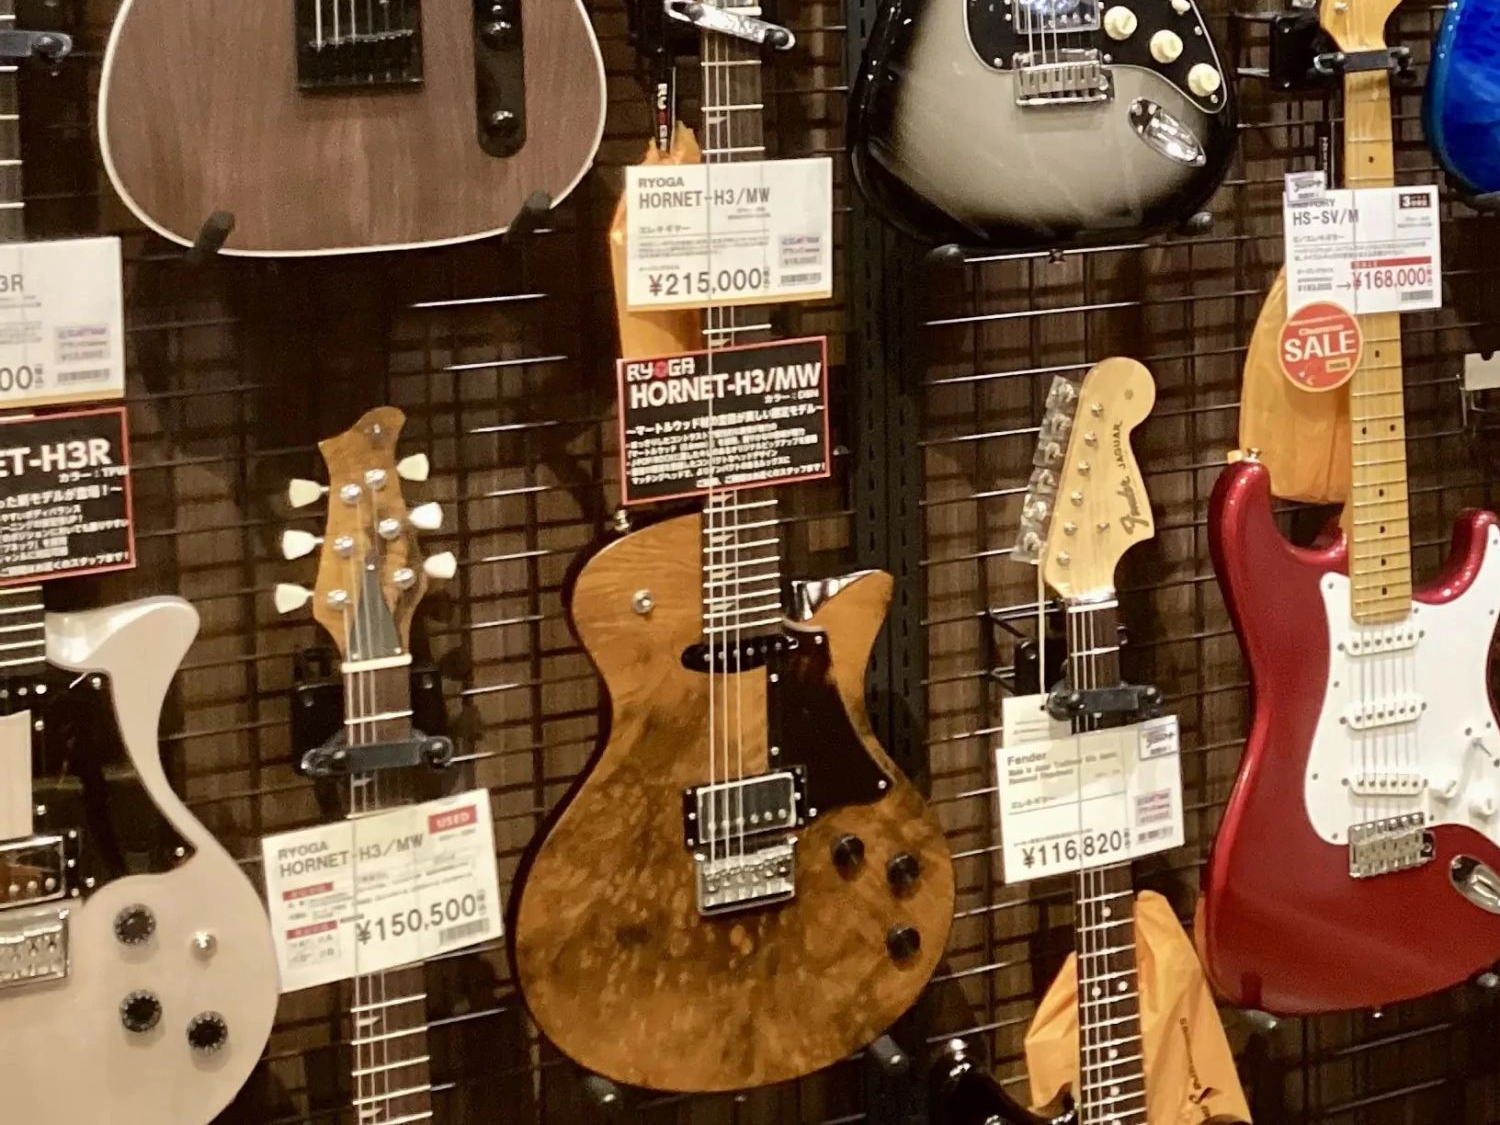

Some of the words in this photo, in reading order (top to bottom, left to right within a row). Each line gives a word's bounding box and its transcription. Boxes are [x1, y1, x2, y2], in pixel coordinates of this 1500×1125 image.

[638, 176, 685, 188] RYOGA
[638, 187, 771, 210] HORNET-H3/MW
[1292, 208, 1359, 226] HS-SV/M
[649, 267, 762, 297] ¥215,000
[1351, 266, 1426, 291] ¥168,000
[1283, 329, 1357, 363] SALE
[630, 361, 822, 409] HORNET-H3/MW
[1111, 420, 1126, 469] JAGUAR
[1006, 751, 1048, 766] Fender
[277, 840, 329, 860] RYOGA
[279, 833, 425, 878] HORNET-H3/MW
[355, 893, 477, 945] ¥150,500
